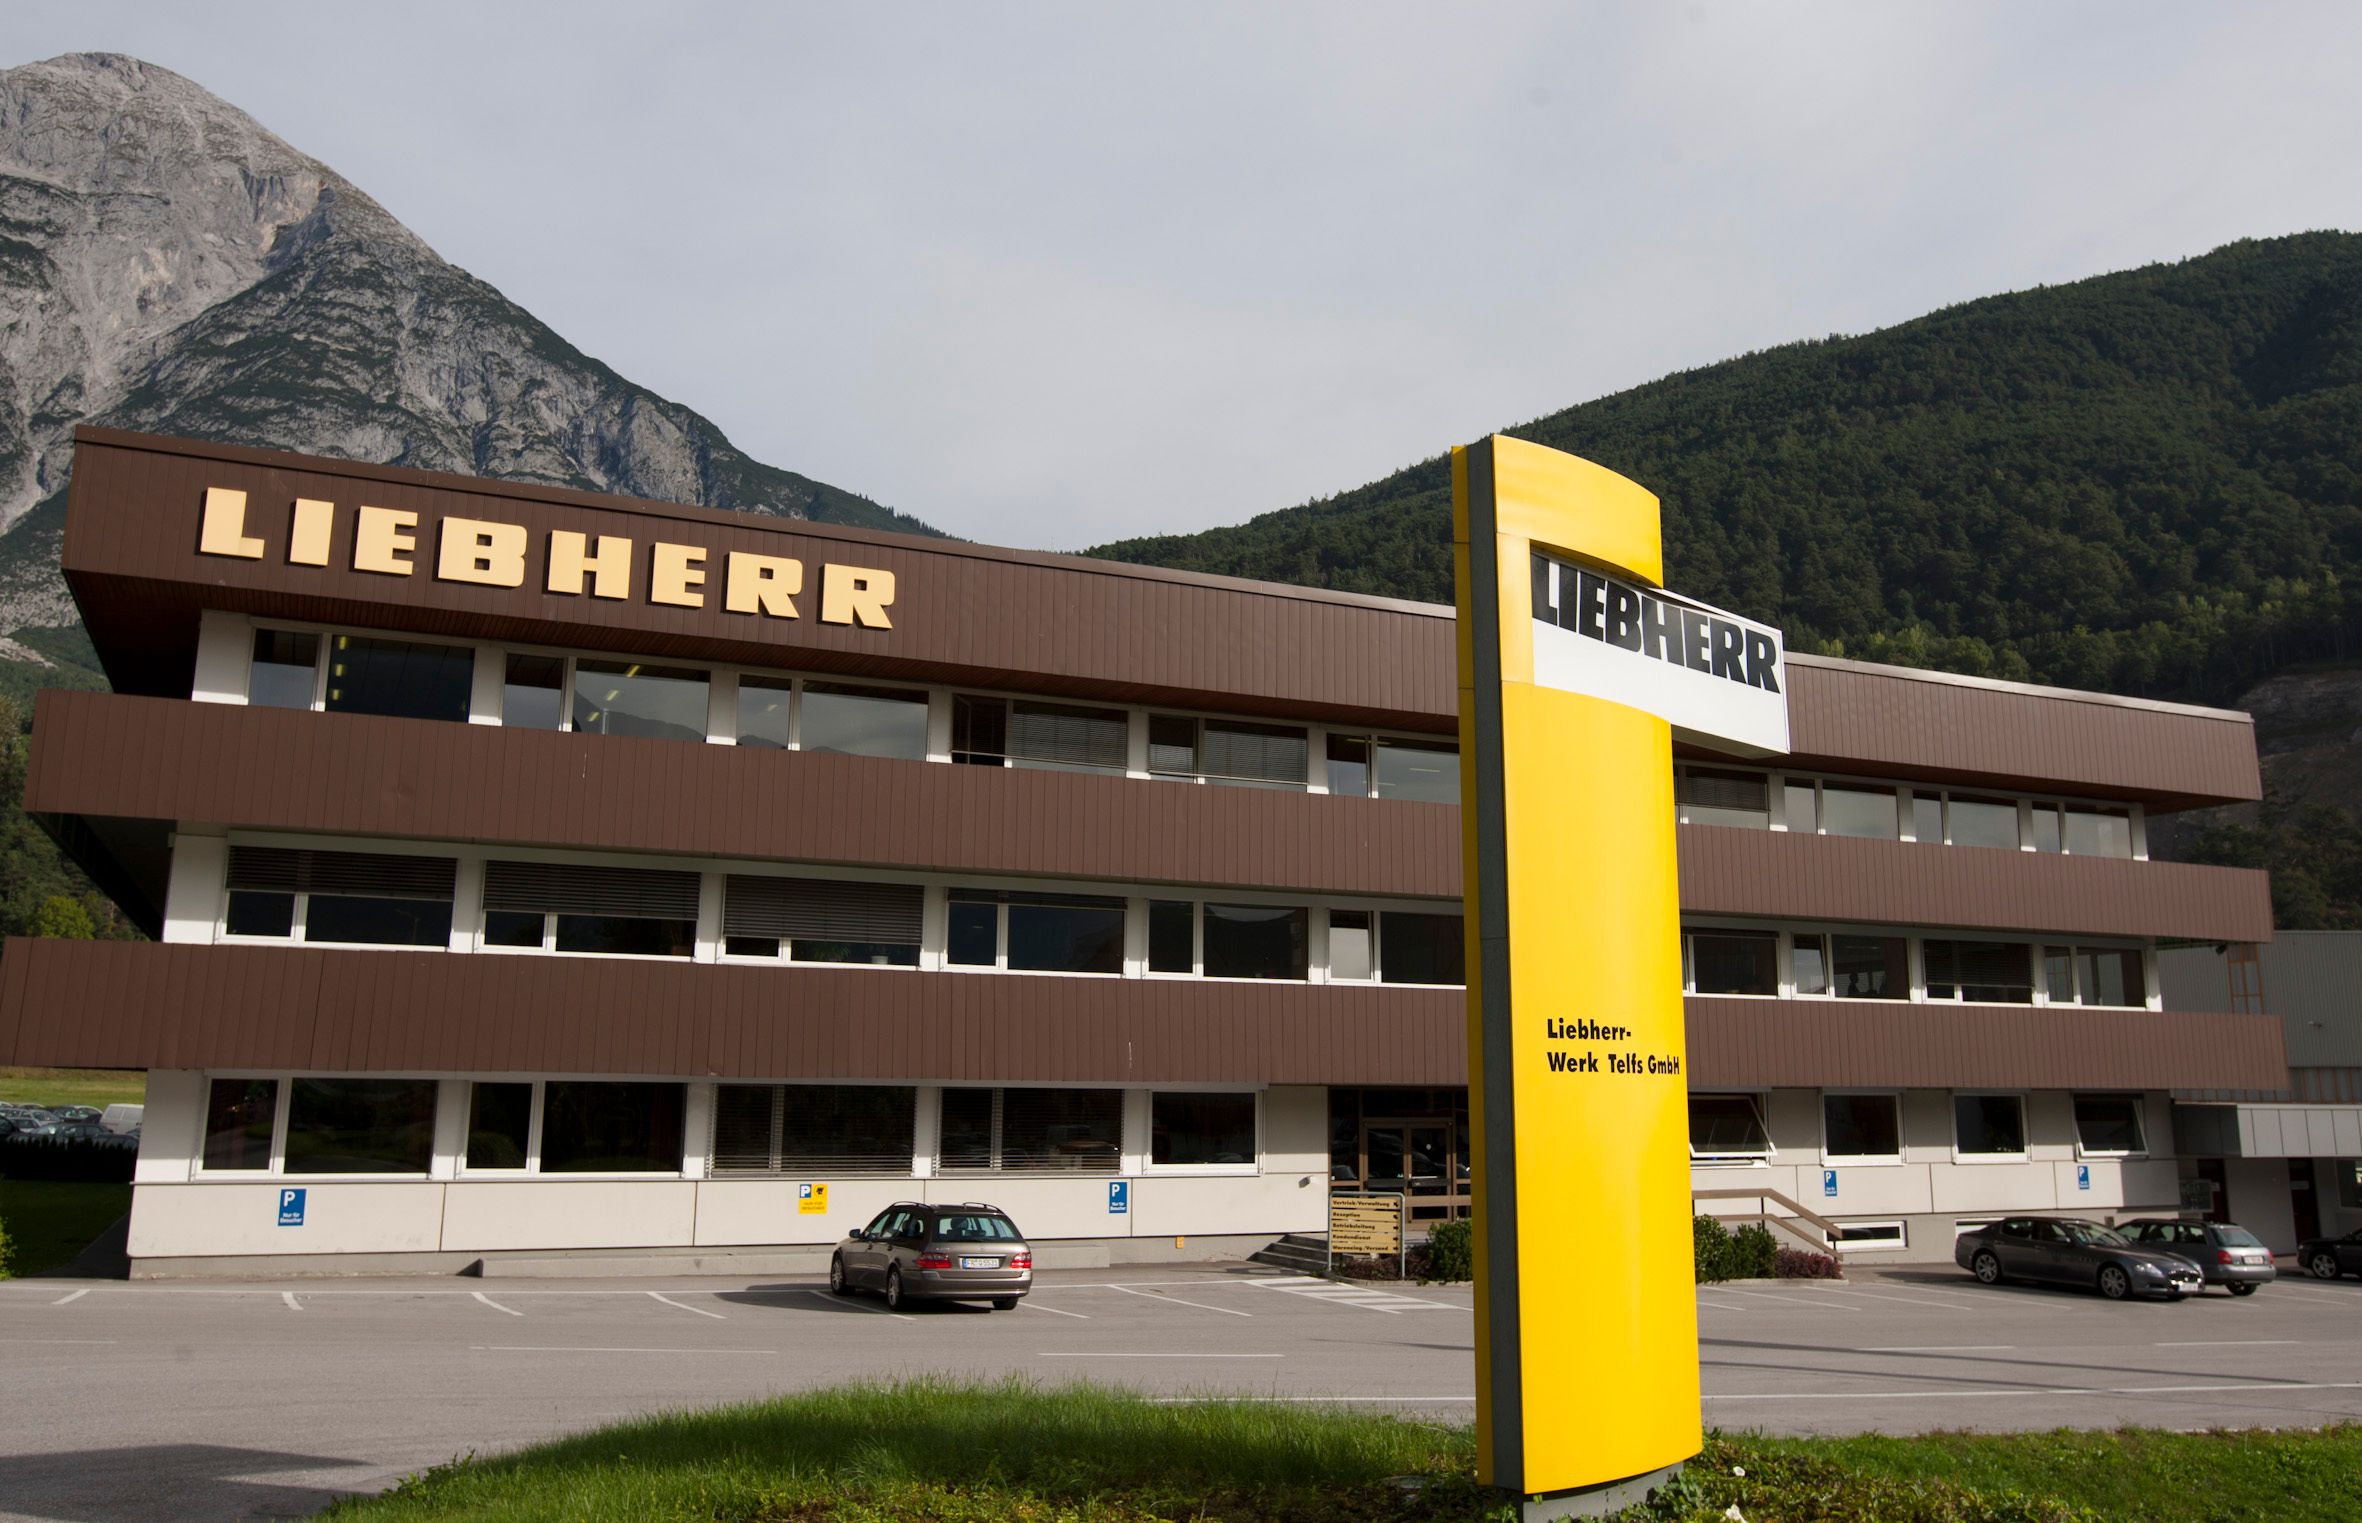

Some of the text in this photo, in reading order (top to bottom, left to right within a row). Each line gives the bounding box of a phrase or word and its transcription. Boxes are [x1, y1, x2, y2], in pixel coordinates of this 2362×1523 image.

[200, 487, 896, 630] LIEBHERR
[1530, 554, 1780, 694] LIEBHERR
[1547, 1018, 1631, 1040] Liebherr-
[1547, 1052, 1680, 1075] Werk Telfs GmbH
[284, 1191, 296, 1207] P
[800, 1185, 811, 1197] P
[1112, 1184, 1120, 1197] P
